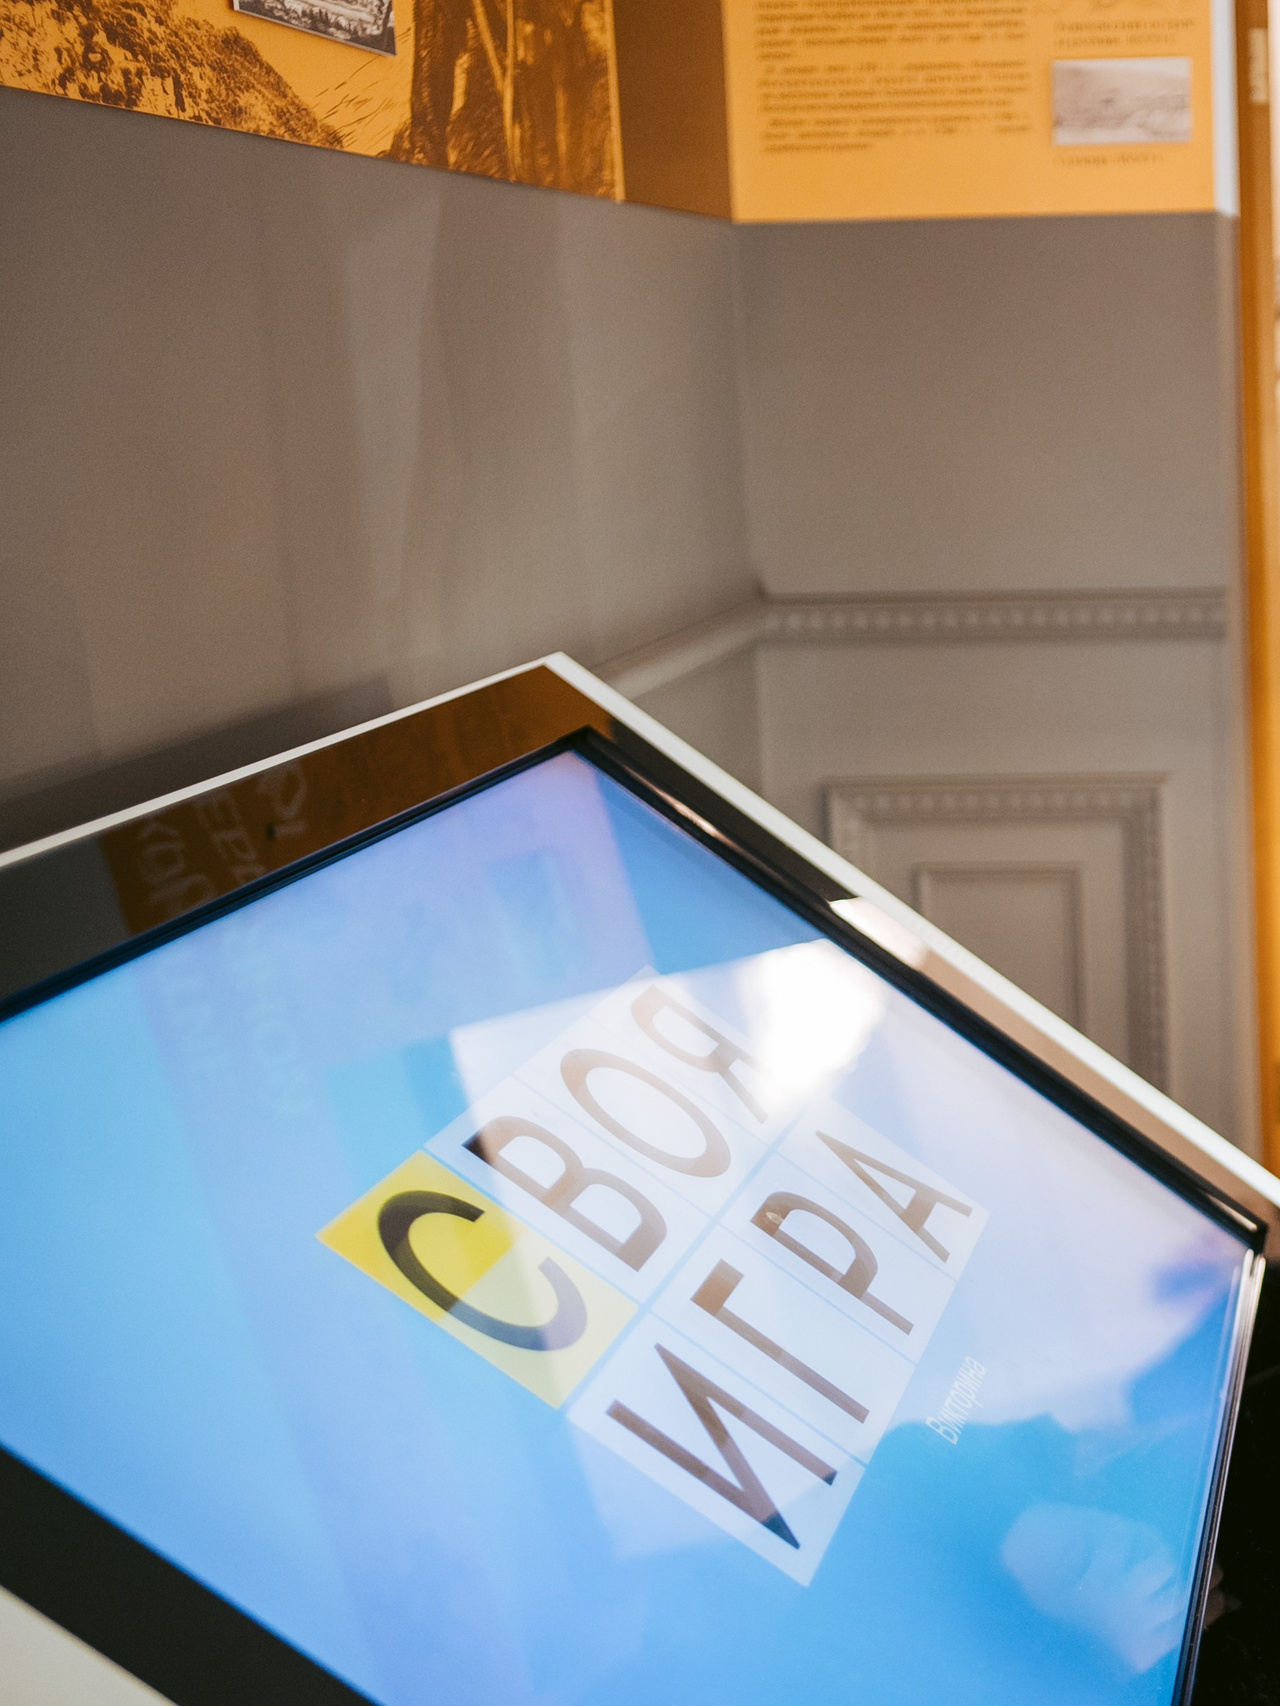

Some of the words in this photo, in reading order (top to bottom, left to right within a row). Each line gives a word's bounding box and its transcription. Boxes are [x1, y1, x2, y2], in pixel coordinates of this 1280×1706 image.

[377, 985, 768, 1352] СВОЯ
[605, 1130, 973, 1550] ИГРА
[925, 1355, 988, 1445] Викторина
